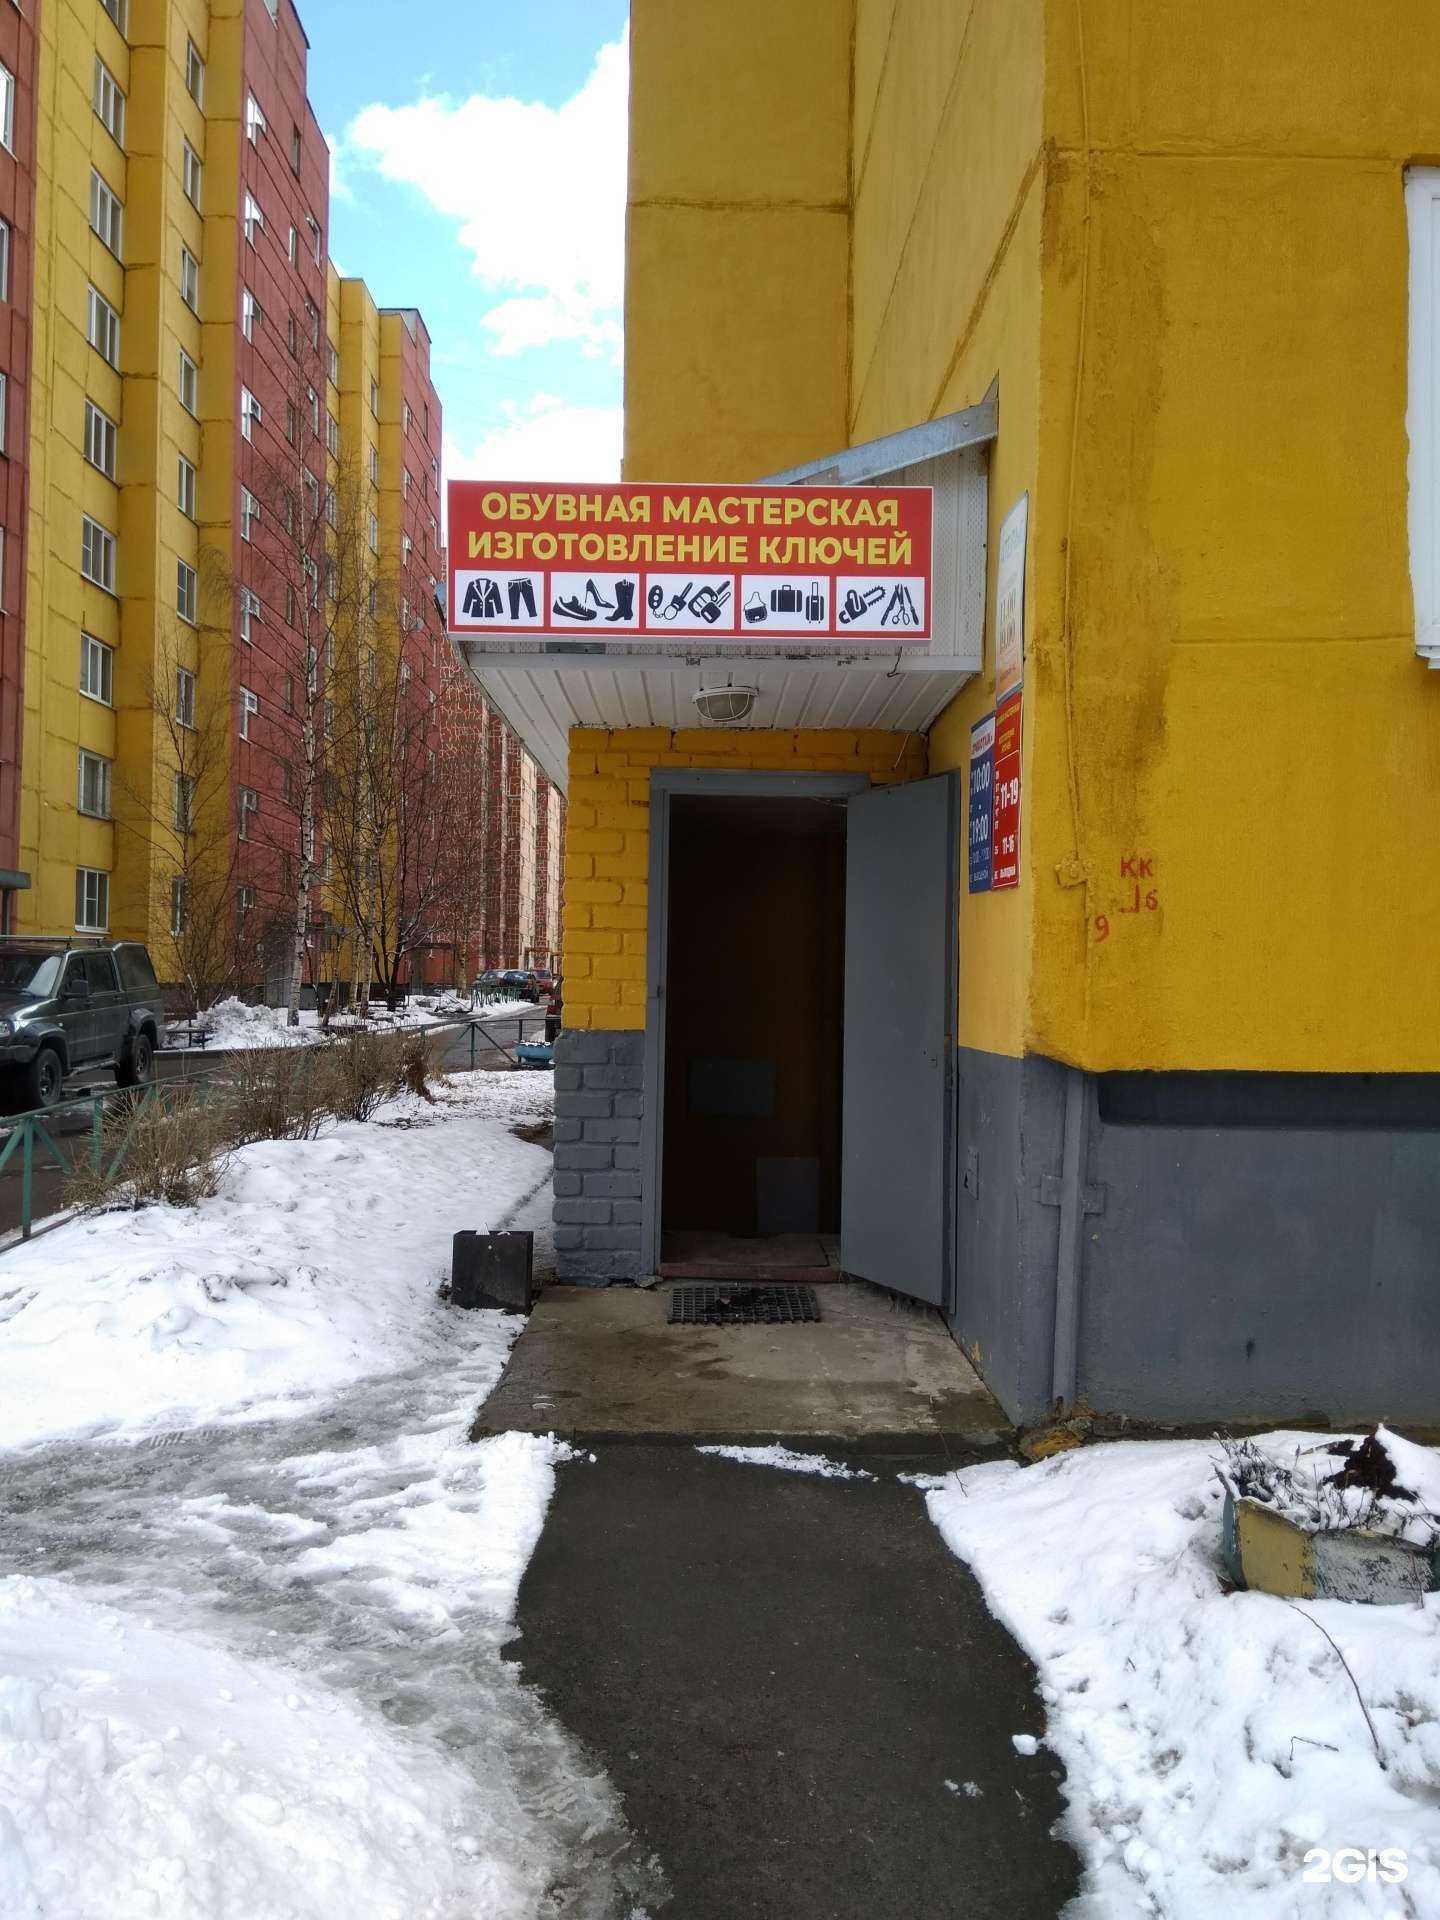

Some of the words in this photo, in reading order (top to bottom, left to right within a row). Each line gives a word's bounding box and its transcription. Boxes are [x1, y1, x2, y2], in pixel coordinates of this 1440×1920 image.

[481, 492, 651, 524] ОБУВНАЯ
[663, 496, 898, 527] МАСТЕРСКАЯ
[467, 532, 748, 564] ИЗГОТОВЛЕНИЕ
[759, 531, 913, 566] КЛЮЧЕЙ
[974, 760, 990, 793] 10:00
[1000, 777, 1018, 810] 11-19
[972, 813, 989, 844] 19:00
